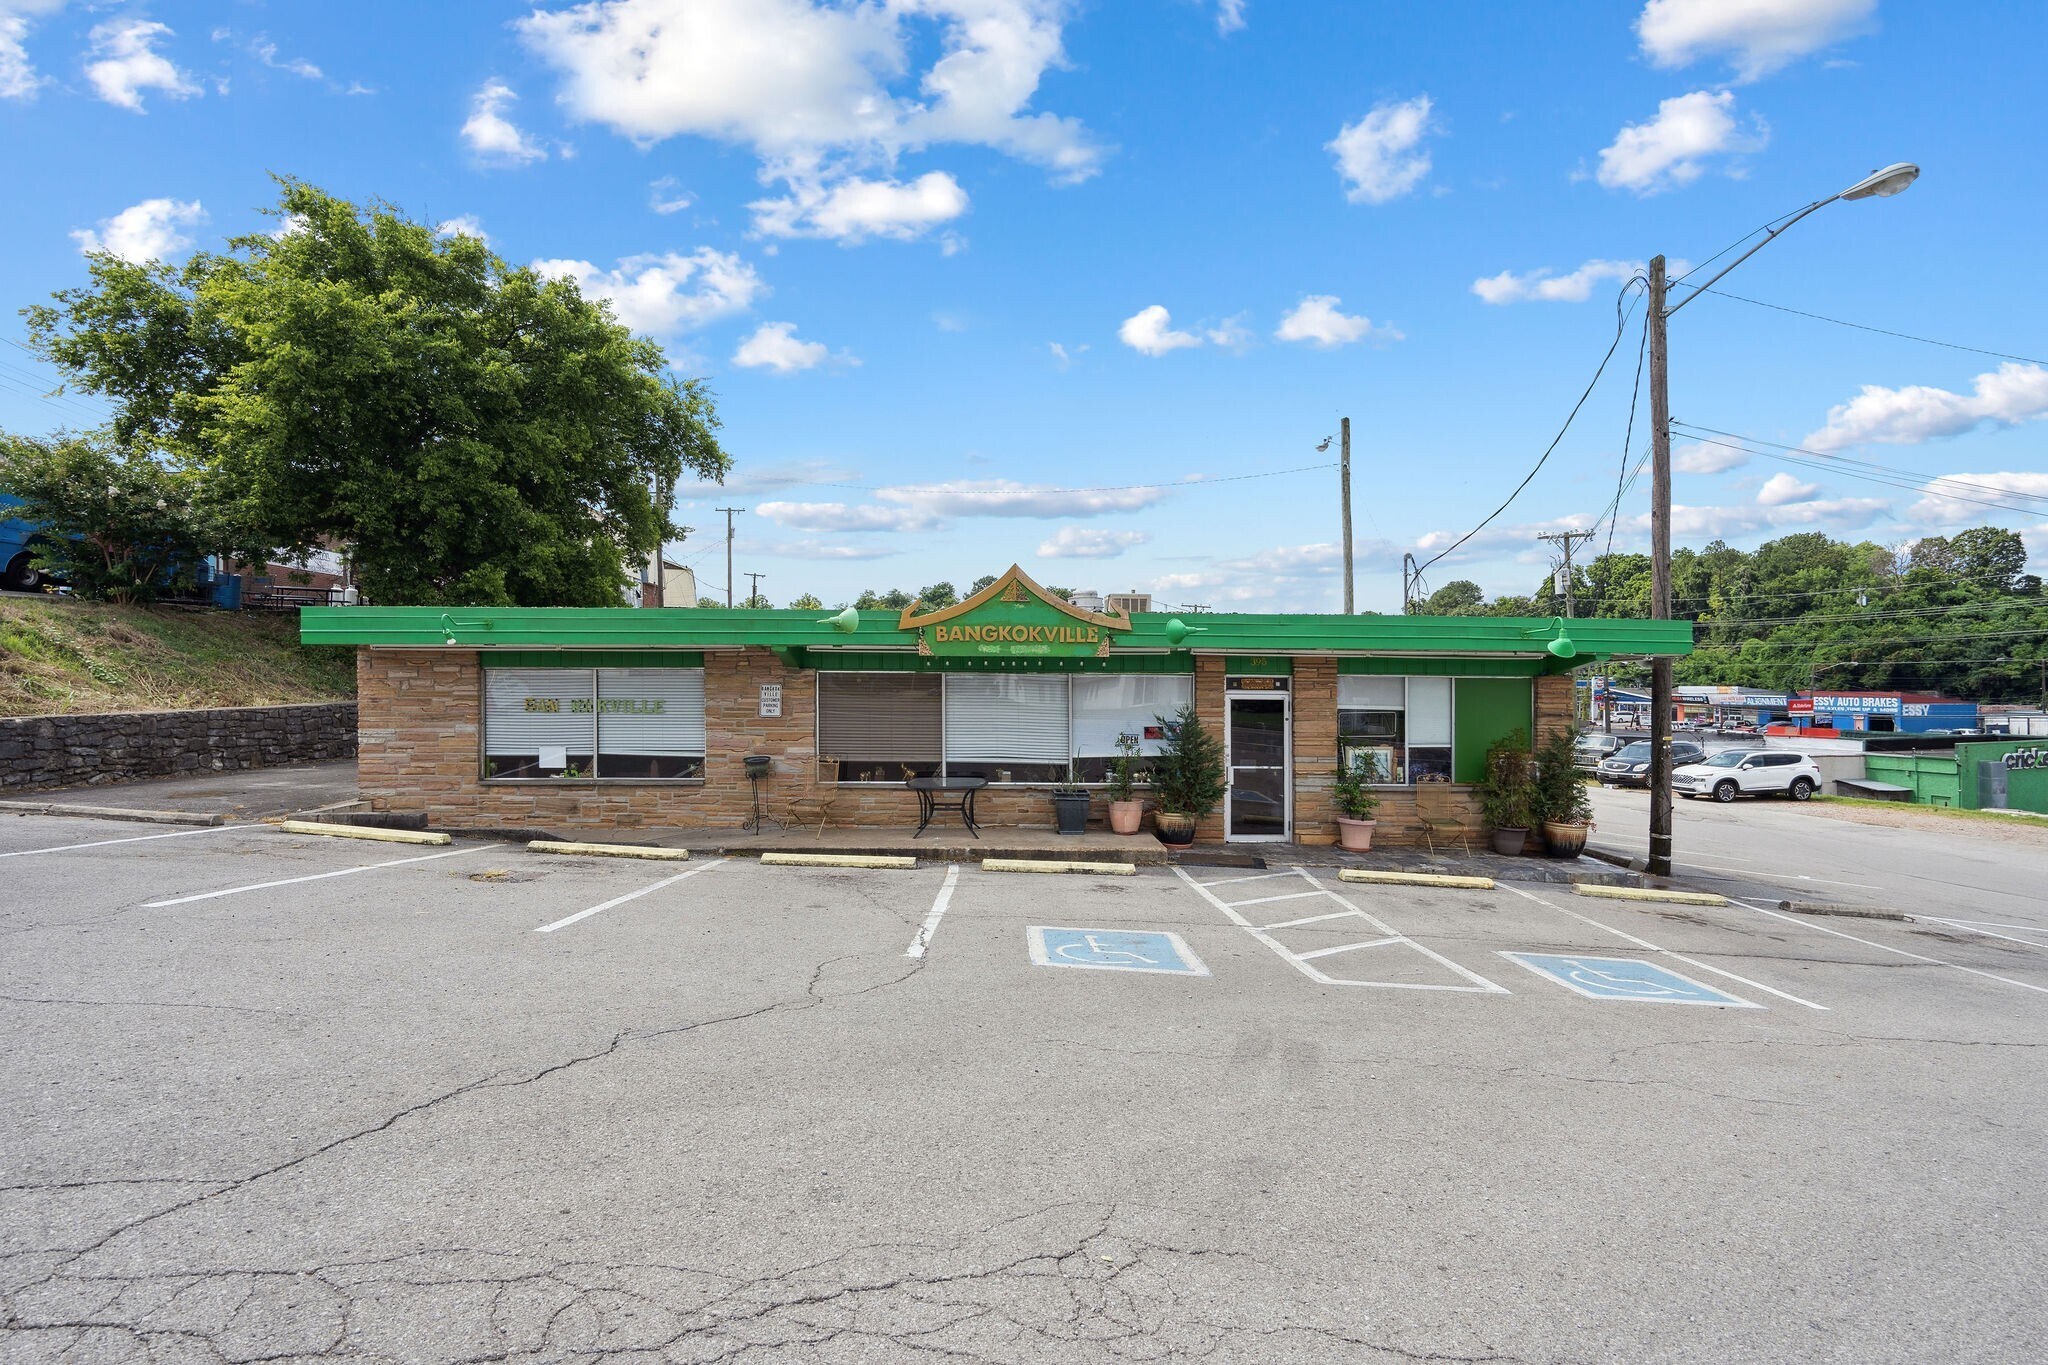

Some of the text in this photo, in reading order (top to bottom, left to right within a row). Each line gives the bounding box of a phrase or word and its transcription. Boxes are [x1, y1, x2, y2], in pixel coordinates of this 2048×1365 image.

[935, 625, 1099, 643] BANGKOKVILLE
[1746, 697, 1788, 706] ALIGNMENT
[1813, 696, 1834, 706] ESSY
[1837, 697, 1860, 707] AUTO
[1862, 698, 1898, 708] BRAKES
[1902, 704, 1930, 717] ESSY
[1120, 735, 1139, 744] OPEN
